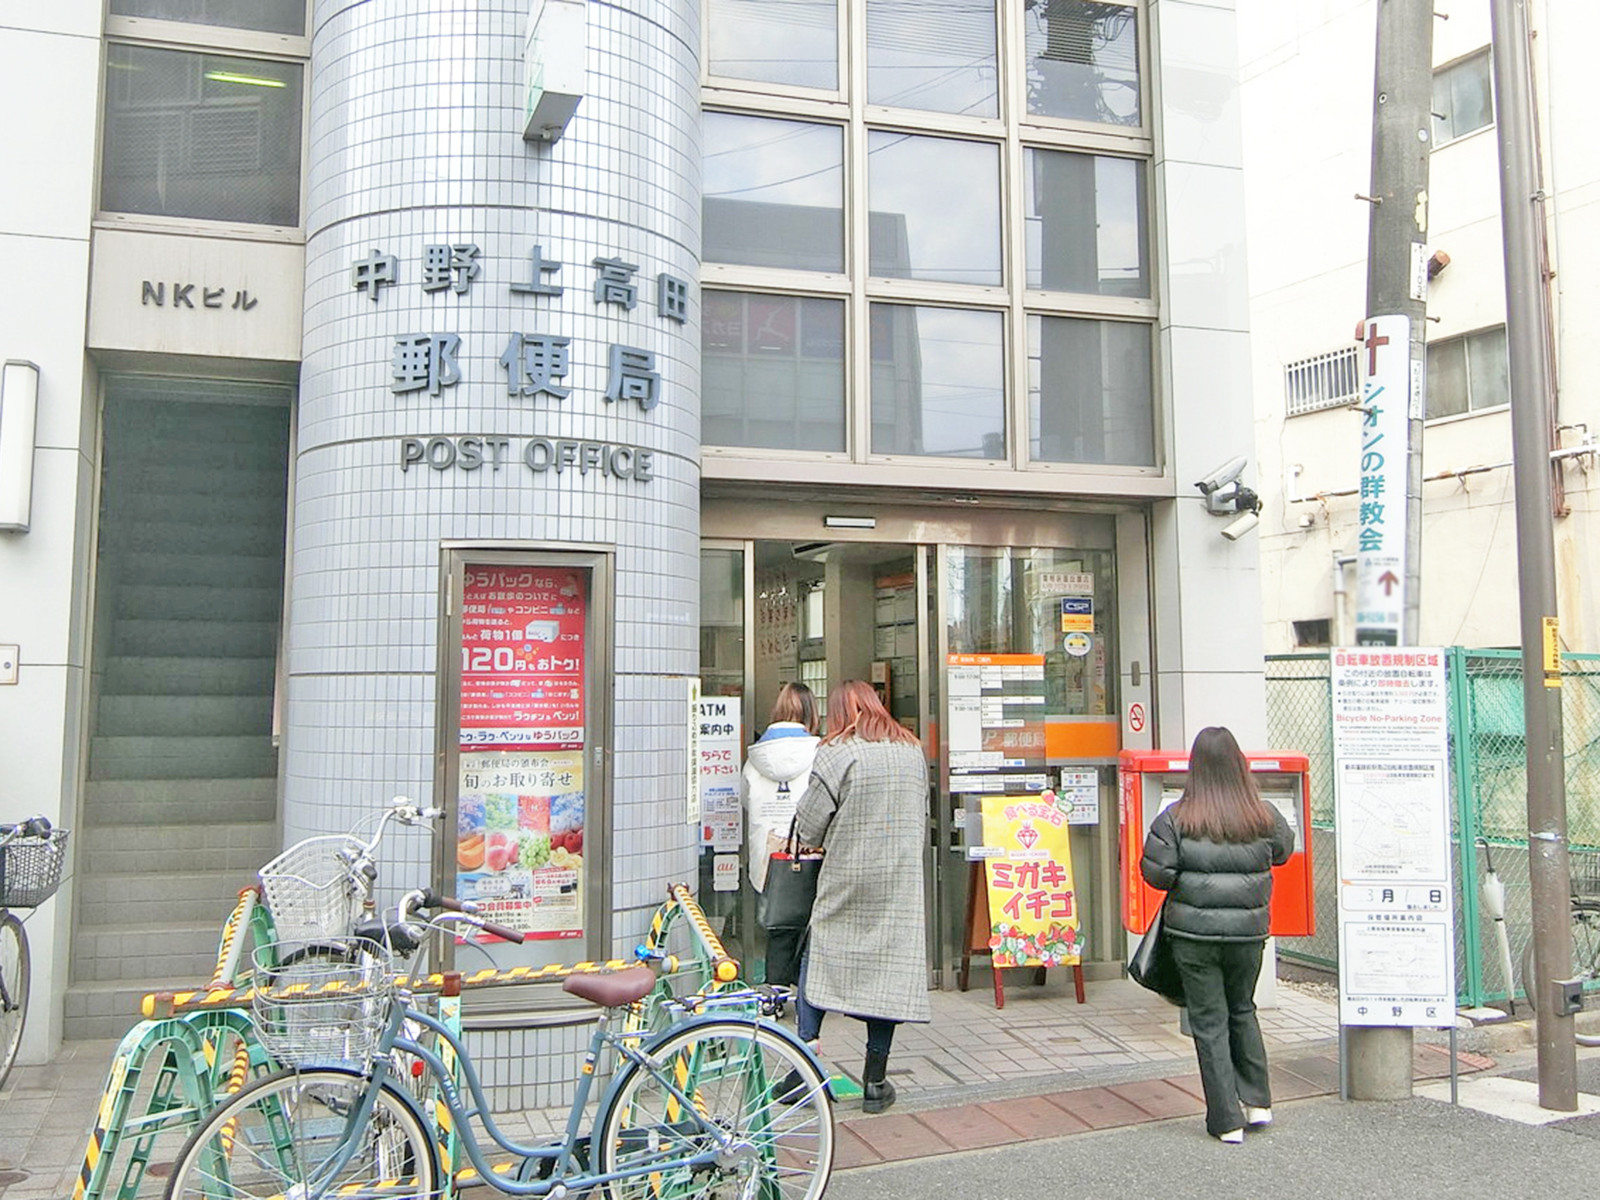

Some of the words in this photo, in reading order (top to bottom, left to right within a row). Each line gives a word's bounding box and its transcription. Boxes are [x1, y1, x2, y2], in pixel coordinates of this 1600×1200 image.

[353, 244, 688, 324] 中野上高田
[141, 280, 257, 312] NKビル
[391, 332, 661, 411] 郵便局
[401, 435, 509, 472] POST
[524, 436, 654, 482] OFFICE
[1359, 382, 1386, 552] シオンの群教会
[1336, 653, 1439, 666] 自転車放置規制区域
[1344, 669, 1432, 678] この付近の放置自転車は
[700, 703, 726, 716] ATM
[1336, 714, 1367, 723] Bicycle
[1369, 714, 1418, 724] No-Parking
[1420, 714, 1443, 722] Zone
[700, 764, 738, 775] ち下さい
[463, 772, 573, 789] 旬のお取り寄せ
[1004, 803, 1066, 827] 食べる宝石
[716, 863, 737, 872] au
[992, 861, 1067, 890] ミガキ
[1382, 889, 1394, 902] 月
[1429, 889, 1442, 903] 日
[1003, 890, 1074, 920] イチゴ
[1358, 1006, 1438, 1018] 中野区
